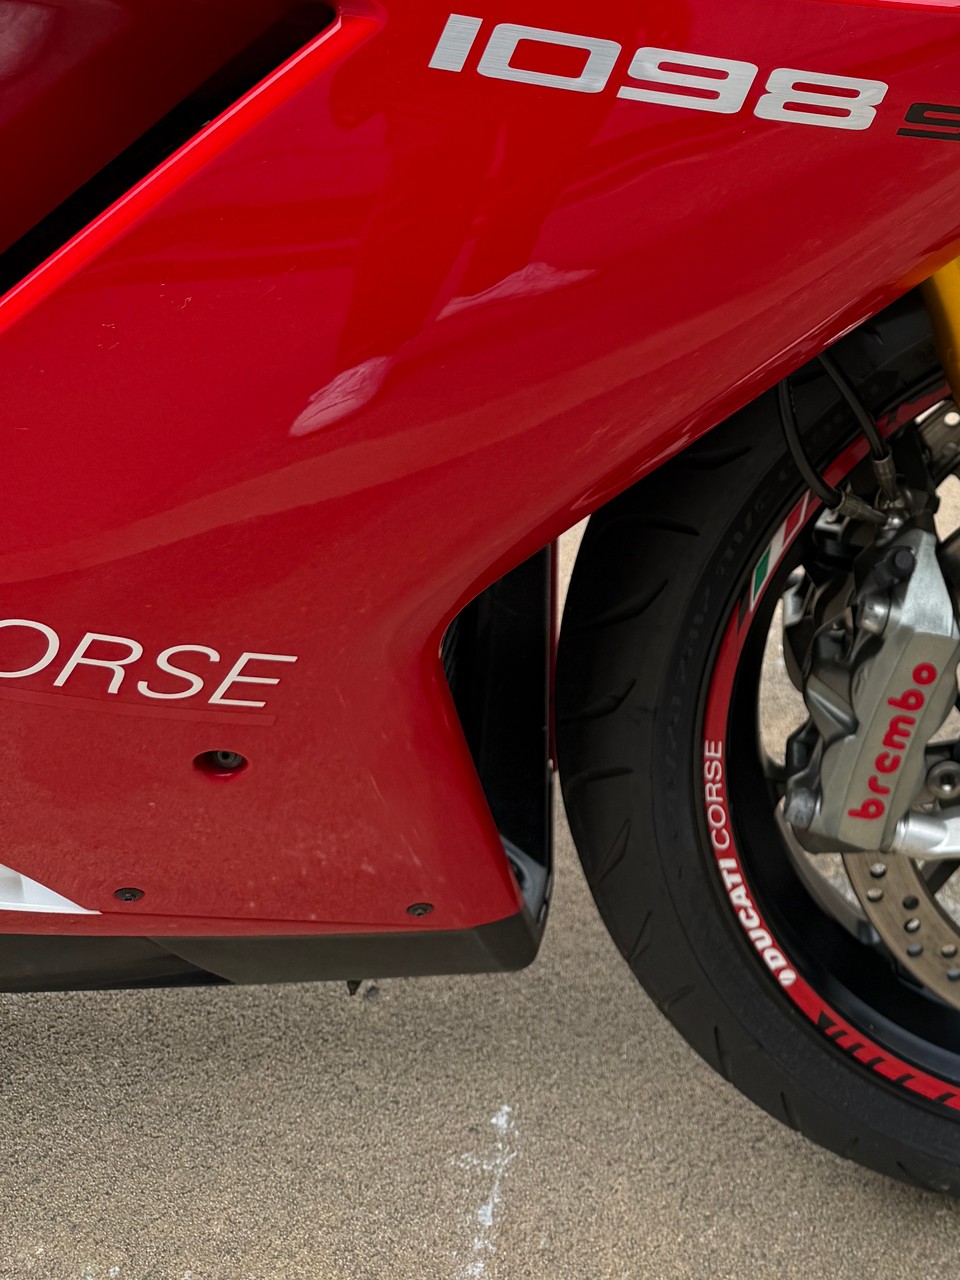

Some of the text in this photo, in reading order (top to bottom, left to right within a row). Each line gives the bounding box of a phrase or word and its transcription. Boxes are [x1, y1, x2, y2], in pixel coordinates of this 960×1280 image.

[427, 12, 889, 131] 1098
[847, 661, 938, 821] brembo
[703, 739, 788, 971] DUCATI CORSE
